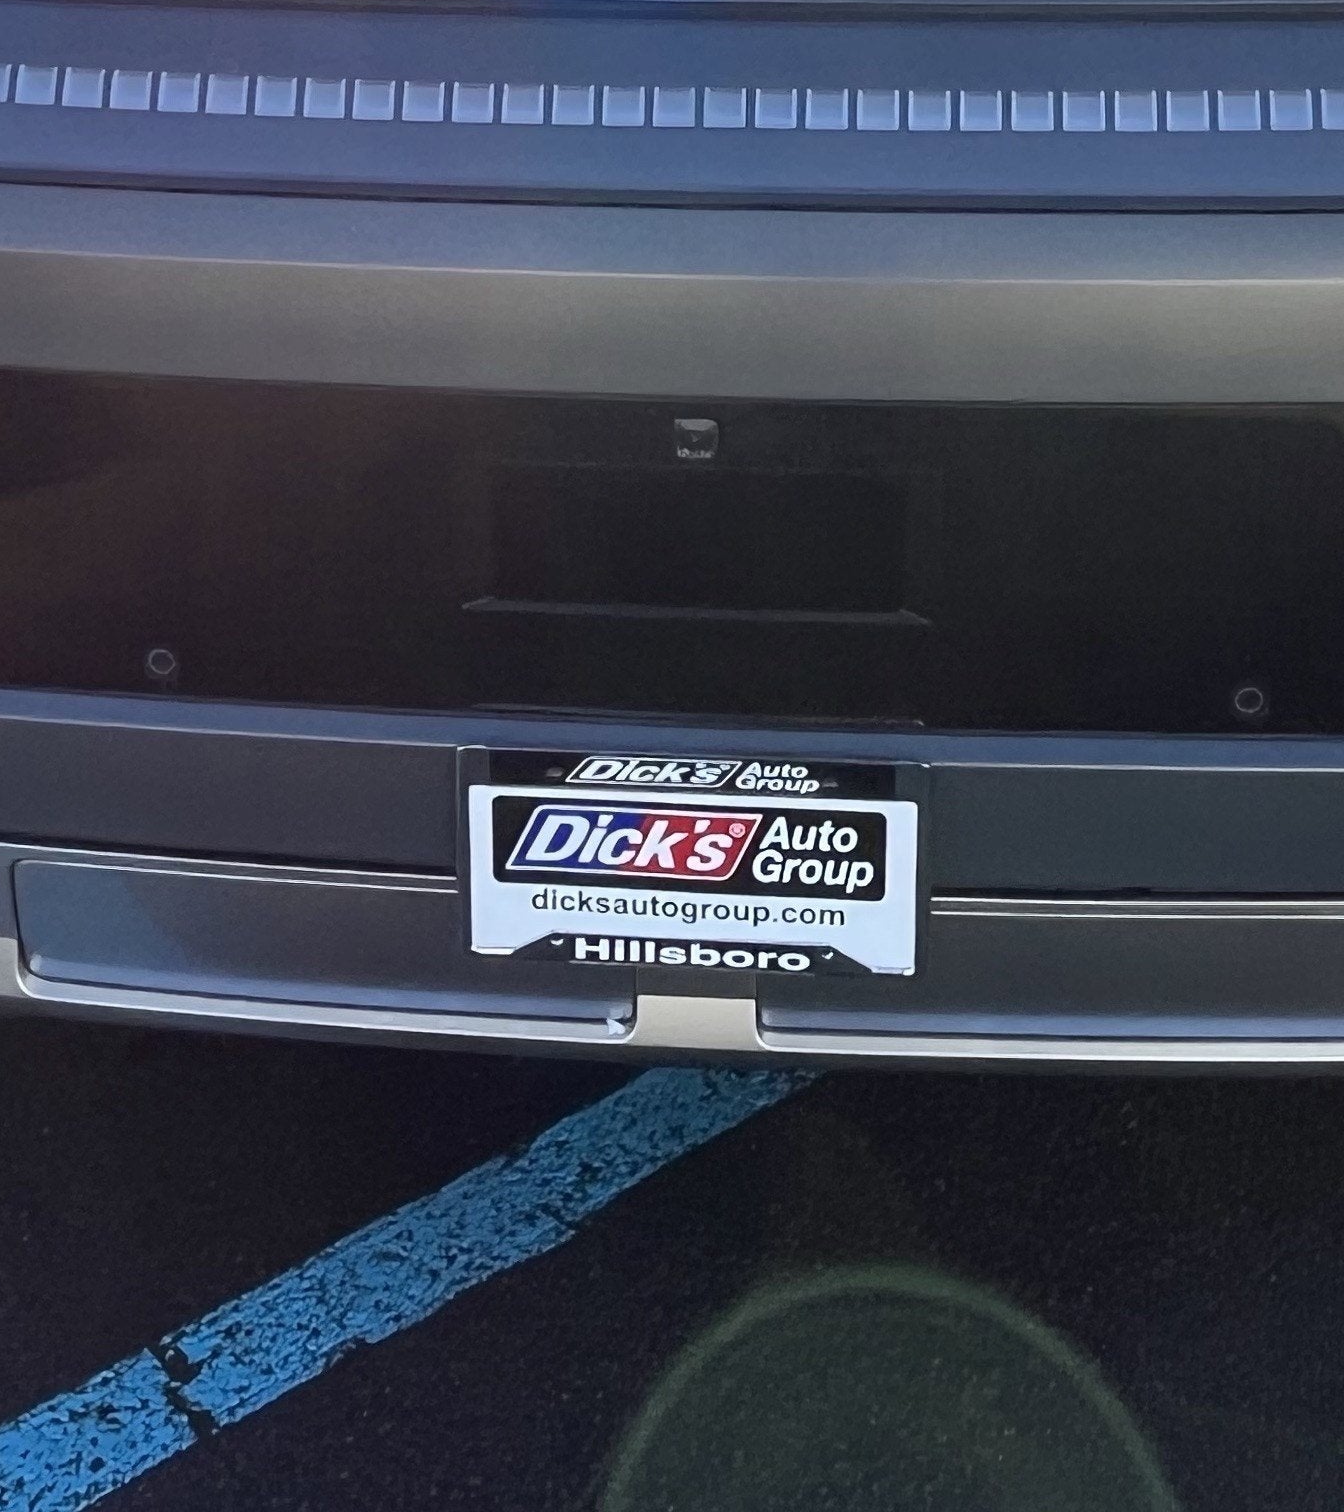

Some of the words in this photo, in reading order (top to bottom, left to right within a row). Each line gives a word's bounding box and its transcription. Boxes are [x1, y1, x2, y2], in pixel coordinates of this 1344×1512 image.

[735, 774, 820, 795] Group
[744, 761, 809, 779] Auto
[524, 814, 736, 872] Dick's
[759, 816, 859, 853] Auto
[751, 848, 874, 894] Group
[531, 888, 845, 927] dicksautogroup.com
[574, 937, 811, 971] Hillsboro
